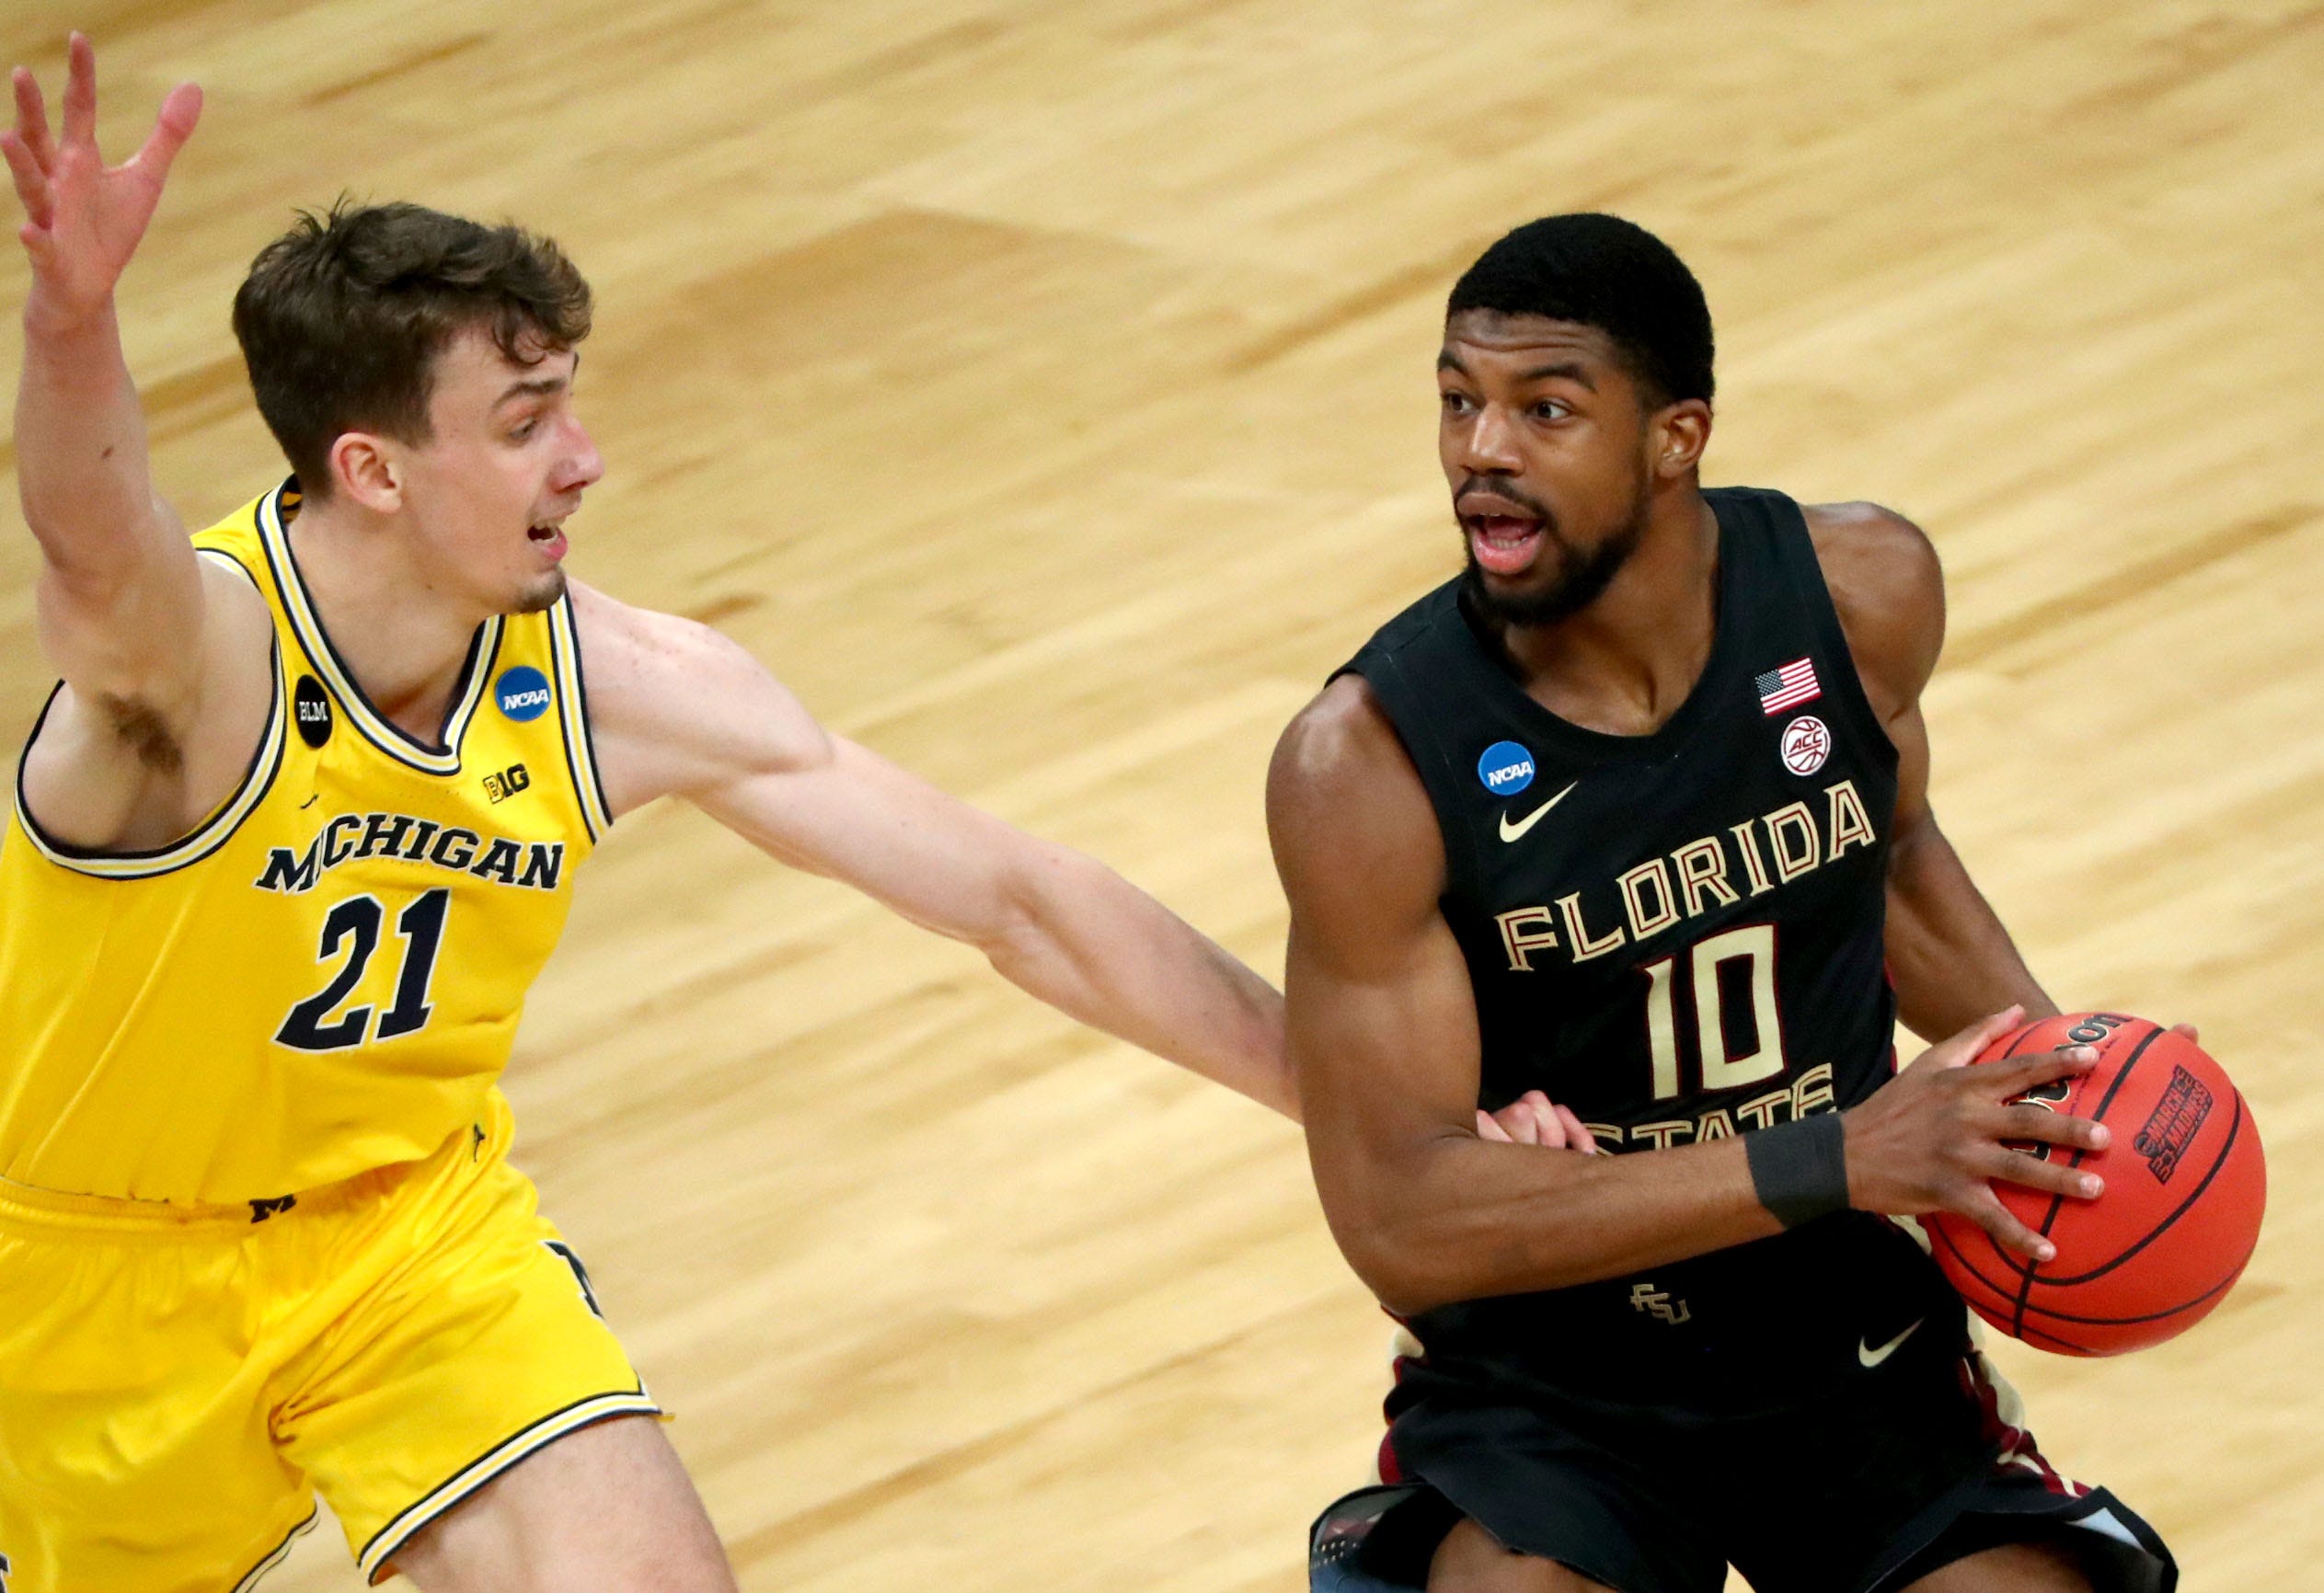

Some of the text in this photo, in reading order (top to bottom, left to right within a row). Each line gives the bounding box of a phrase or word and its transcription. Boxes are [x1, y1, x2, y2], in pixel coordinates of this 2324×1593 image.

[299, 701, 328, 721] BLM
[504, 689, 549, 710] NCAA
[1789, 729, 1823, 752] ACC
[1488, 761, 1533, 786] NCAA
[1494, 780, 1877, 971] FLORIDA
[270, 888, 451, 1053] 21
[1642, 922, 1789, 1102] 10
[2145, 1085, 2186, 1143] MARCH
[2164, 1080, 2210, 1149] MADNESS
[1629, 1283, 1691, 1325] FSU
